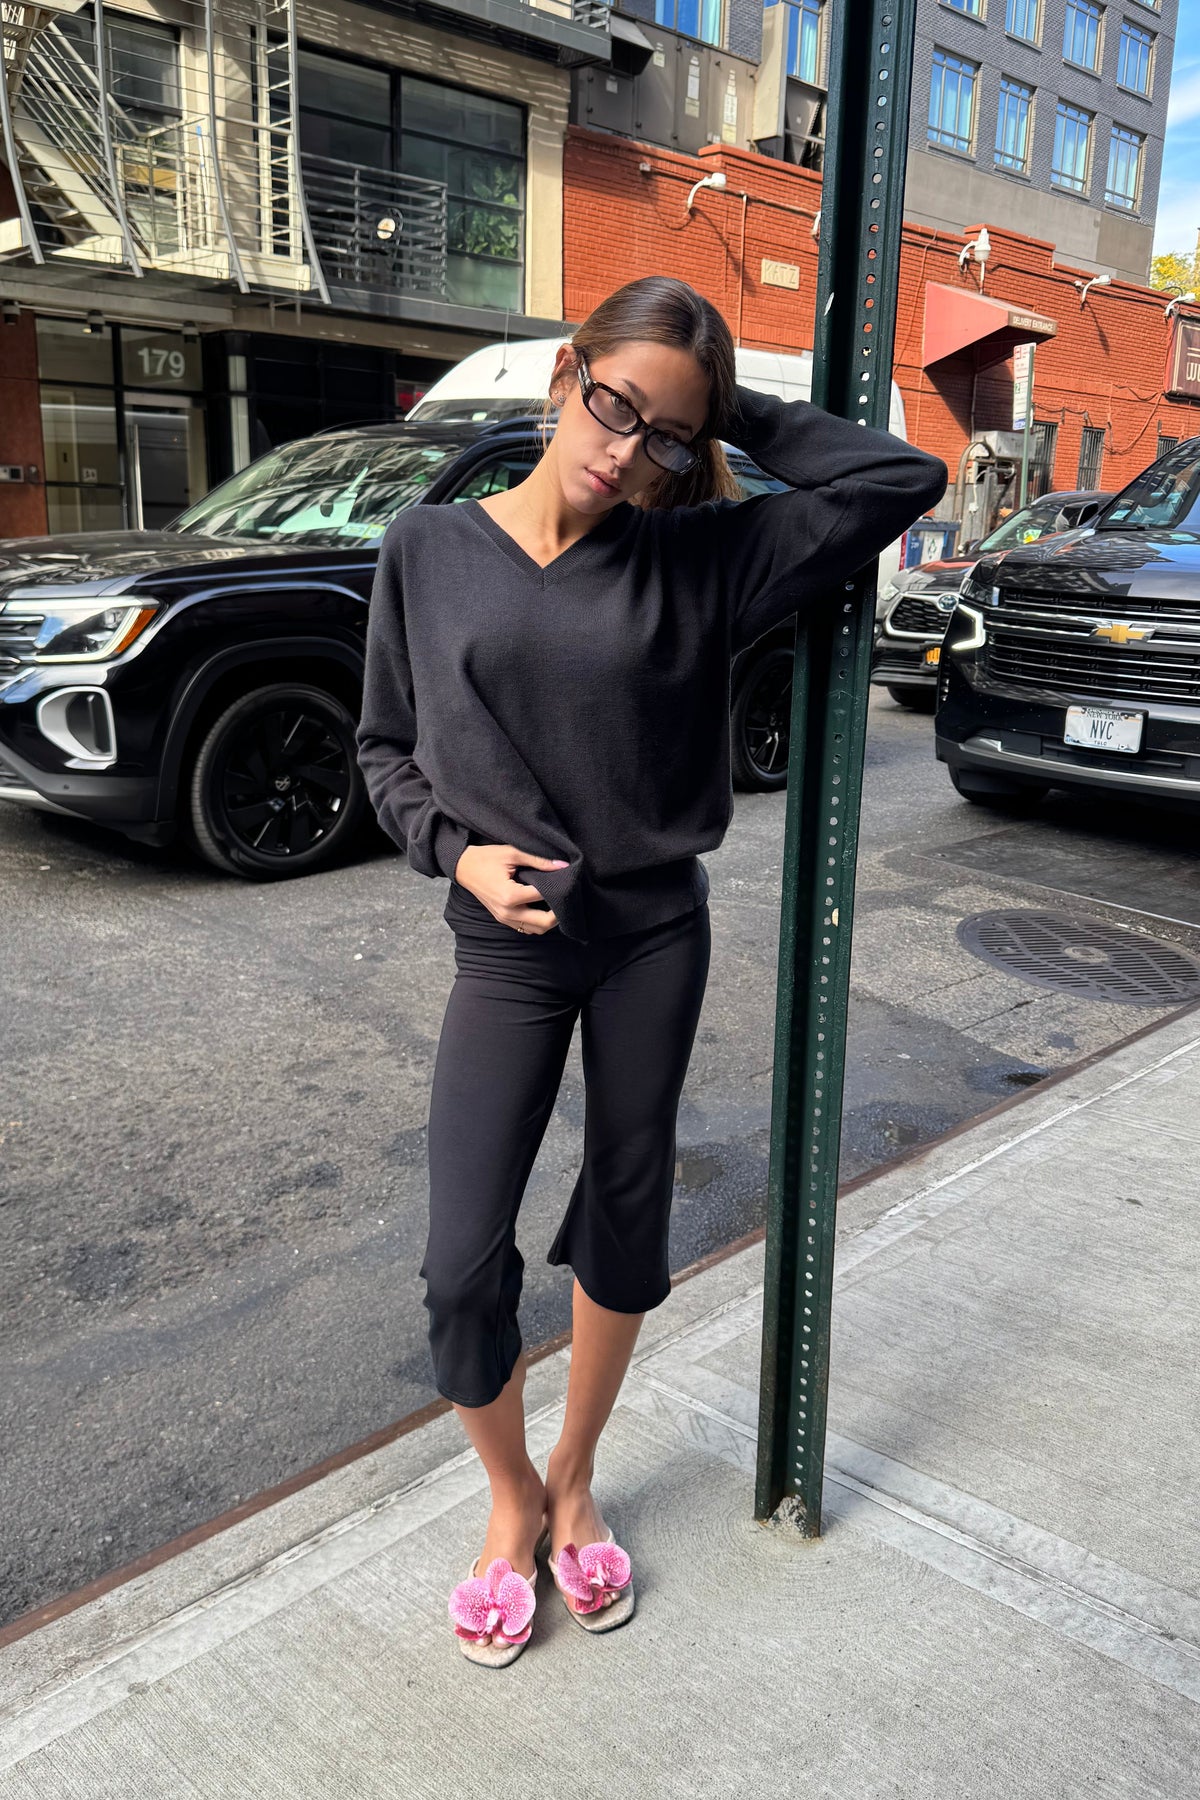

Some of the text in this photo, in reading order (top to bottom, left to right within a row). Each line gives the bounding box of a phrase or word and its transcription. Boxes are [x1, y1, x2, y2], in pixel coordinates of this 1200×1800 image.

[764, 261, 797, 285] KATZ
[138, 347, 185, 378] 179
[1090, 719, 1114, 740] NVC
